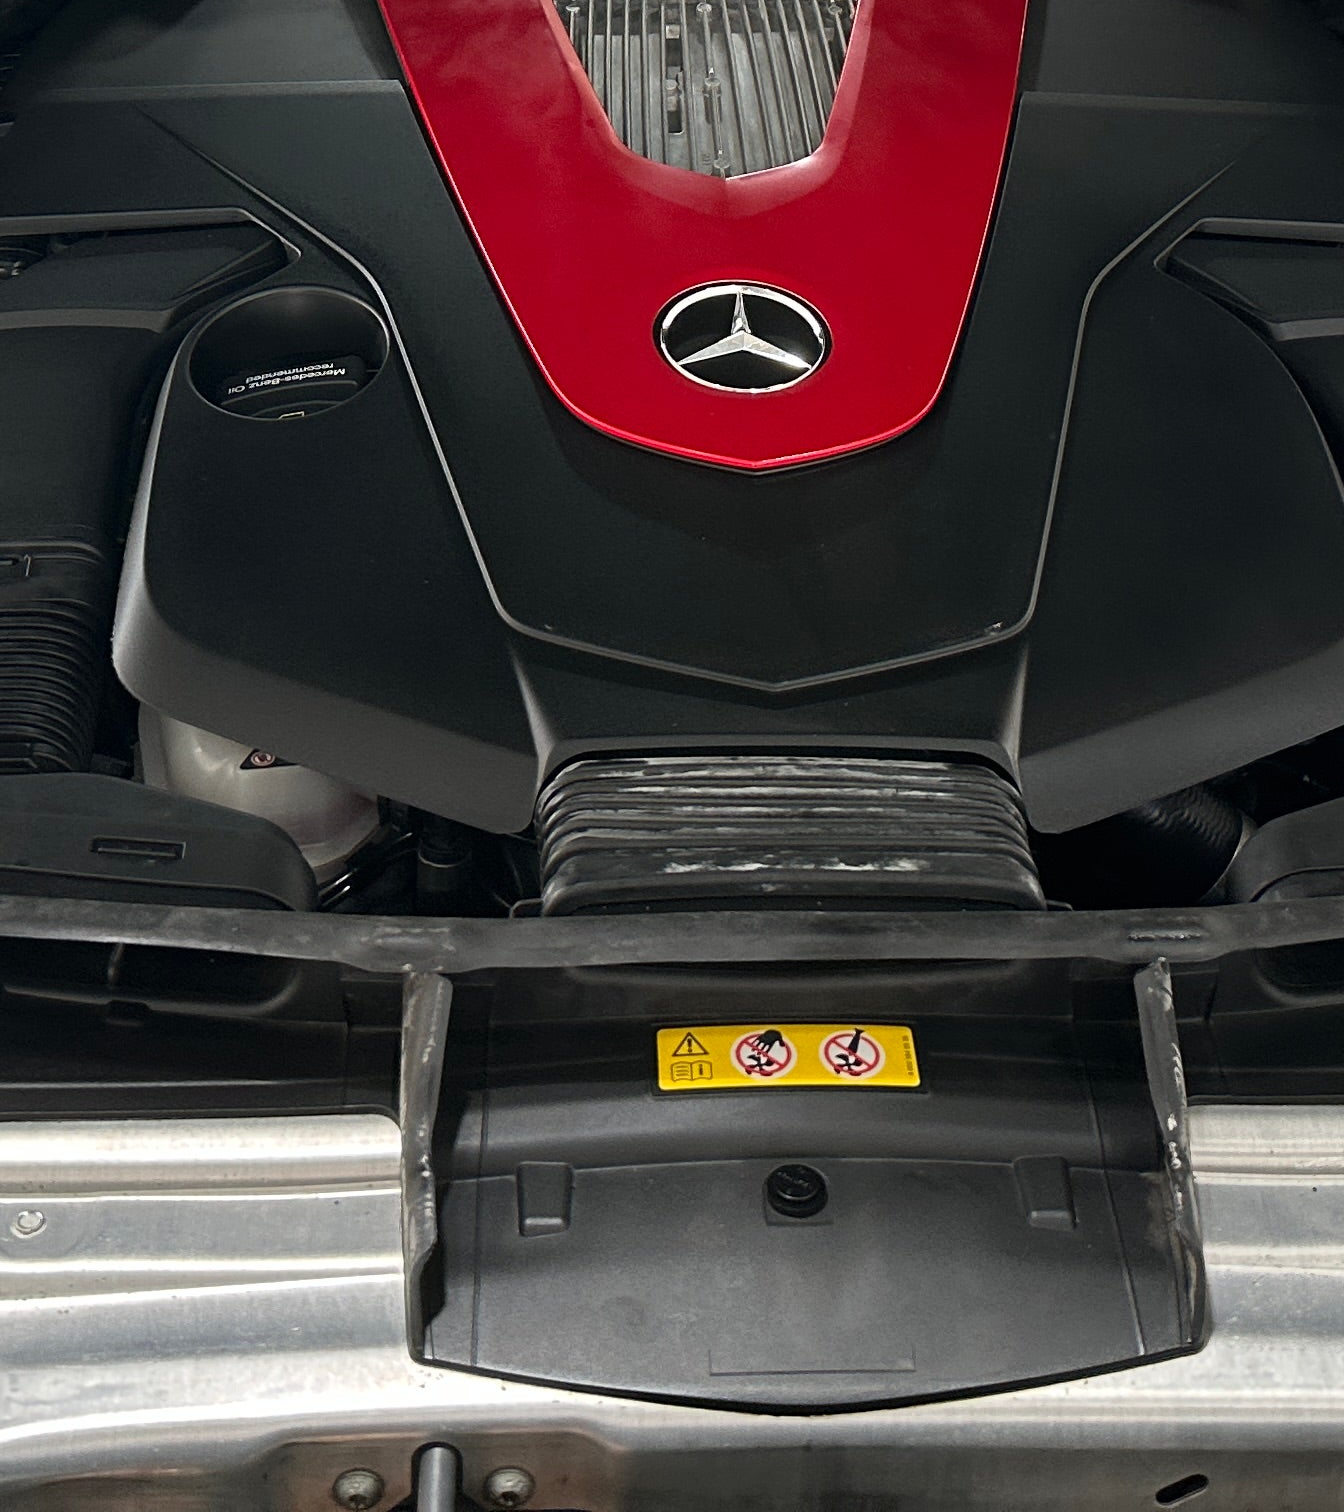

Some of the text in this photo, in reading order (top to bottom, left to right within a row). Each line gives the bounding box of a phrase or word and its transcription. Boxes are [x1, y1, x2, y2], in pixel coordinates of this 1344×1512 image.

[227, 368, 346, 394] Mercedes-Benz Oil
[245, 363, 334, 384] recommended
